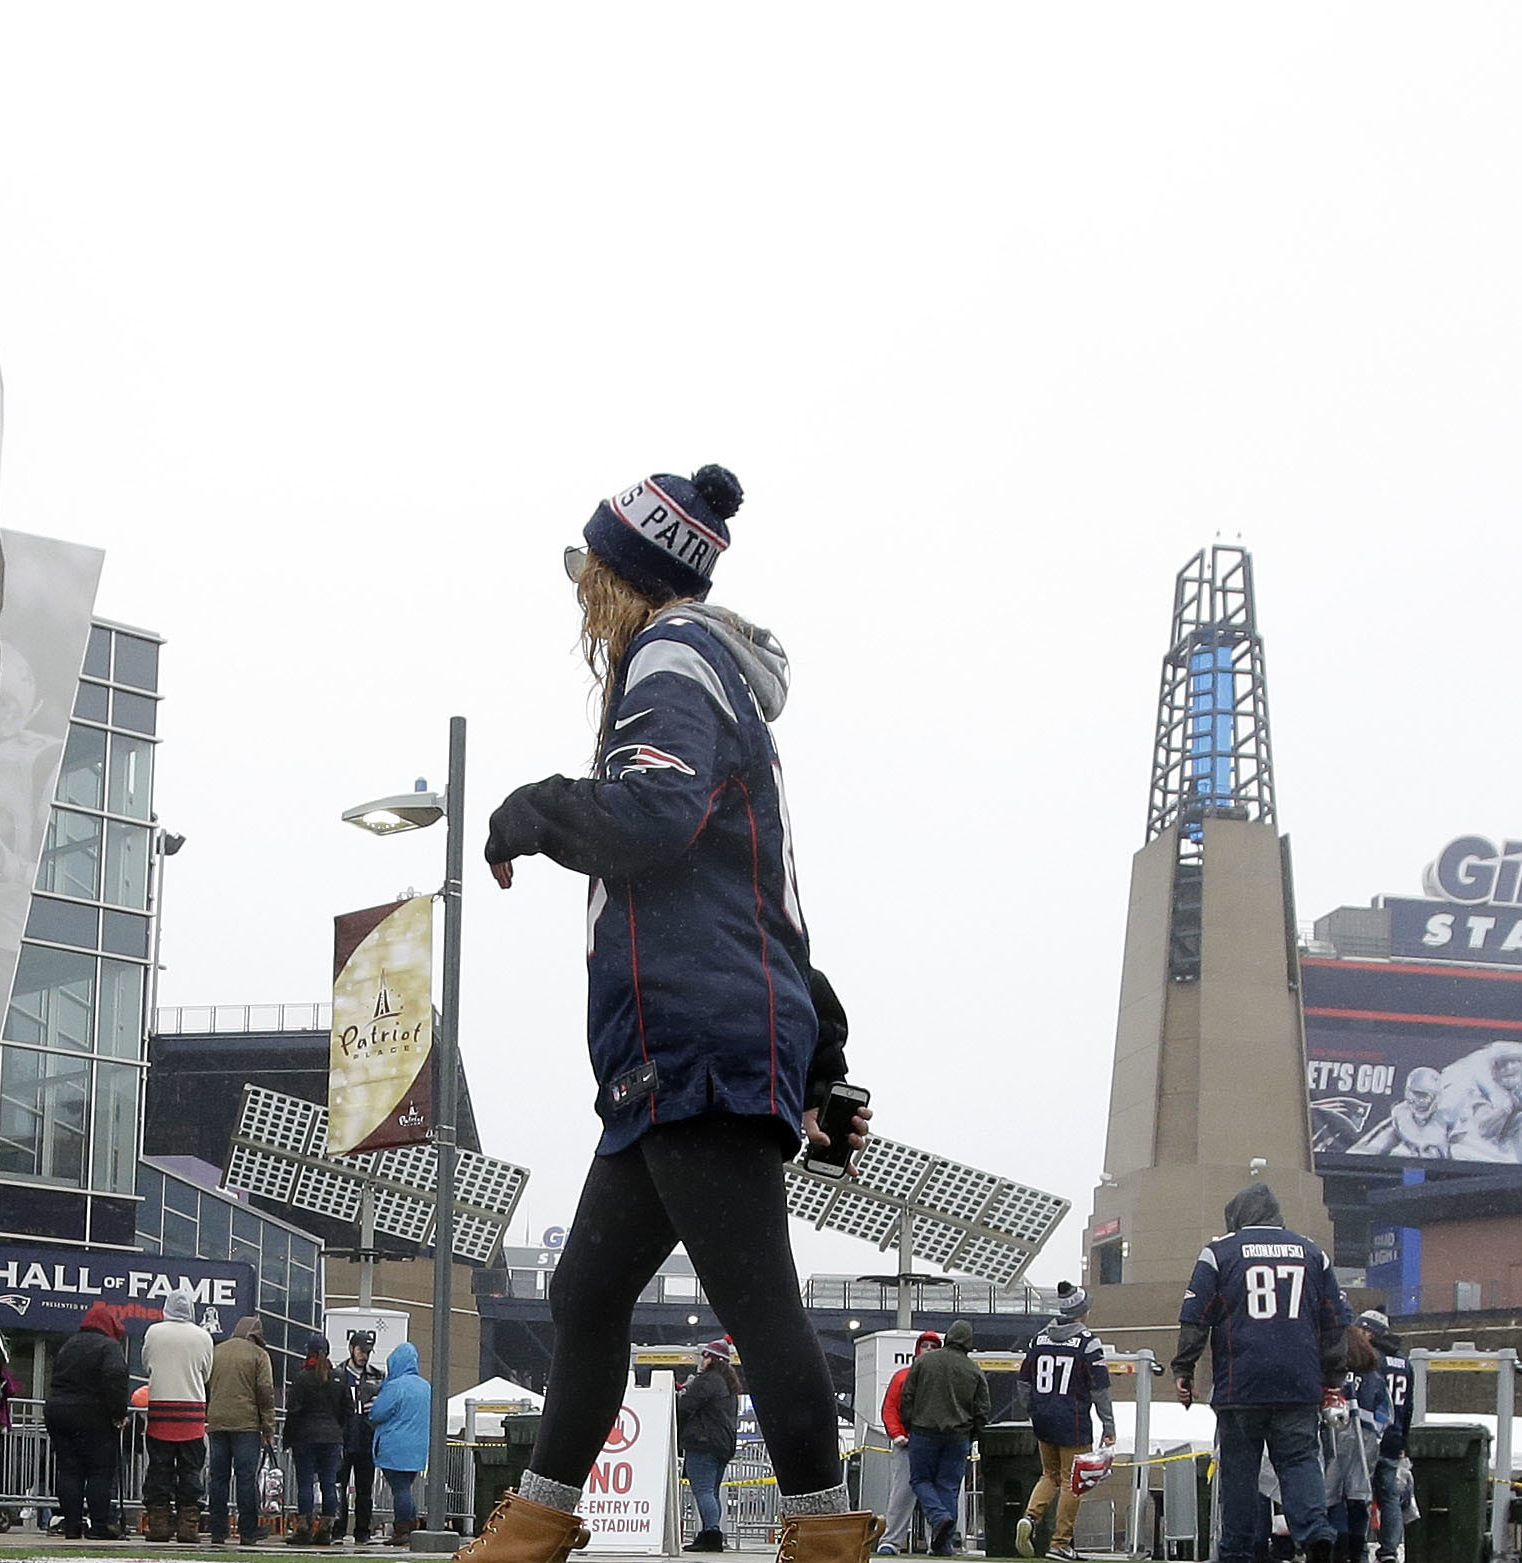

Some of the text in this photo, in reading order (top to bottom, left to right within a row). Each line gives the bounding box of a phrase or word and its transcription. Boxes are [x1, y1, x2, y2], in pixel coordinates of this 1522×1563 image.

[339, 1022, 422, 1057] Patriot
[353, 1044, 411, 1060] PLACE
[1308, 1060, 1395, 1095] ET'S GO!
[104, 1276, 126, 1289] OF
[128, 1271, 237, 1305] FAME
[1245, 1265, 1305, 1319] 87
[41, 1301, 78, 1309] PRESENTED
[1037, 1355, 1074, 1395] 87
[1385, 1373, 1407, 1406] 12
[588, 1462, 633, 1494] NO
[577, 1500, 650, 1514] E-ENTRY TO
[591, 1519, 650, 1532] STADIUM
